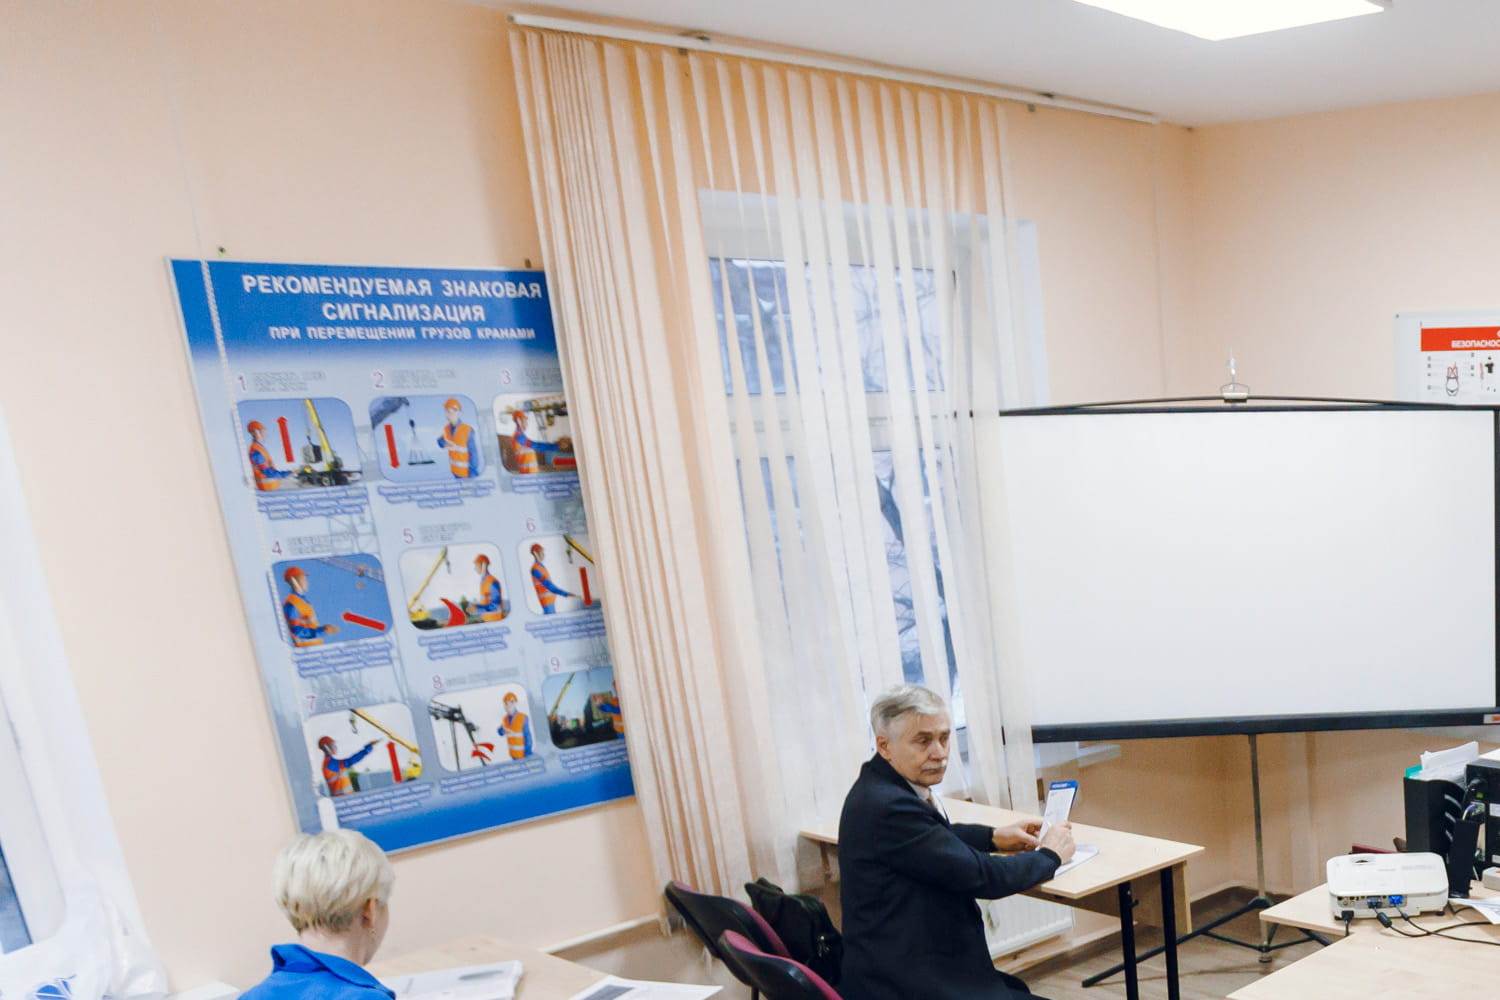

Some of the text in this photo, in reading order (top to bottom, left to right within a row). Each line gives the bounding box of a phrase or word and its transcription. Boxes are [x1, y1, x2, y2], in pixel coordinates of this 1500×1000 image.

[241, 274, 542, 299] РЕКОМЕНДУЕМАЯ ЗНАКОВАЯ
[322, 303, 486, 324] СИГНАЛИЗАЦИЯ
[269, 326, 536, 341] ПРИ ПЕРЕМЕЩЕНИИ ГРУЗОВ КРАНАМИ
[372, 371, 384, 389] 2
[502, 368, 512, 385] 3
[526, 518, 536, 533] 6
[403, 528, 415, 544] 5
[272, 541, 282, 555] 4
[550, 656, 560, 671] 9
[432, 675, 443, 690] 8
